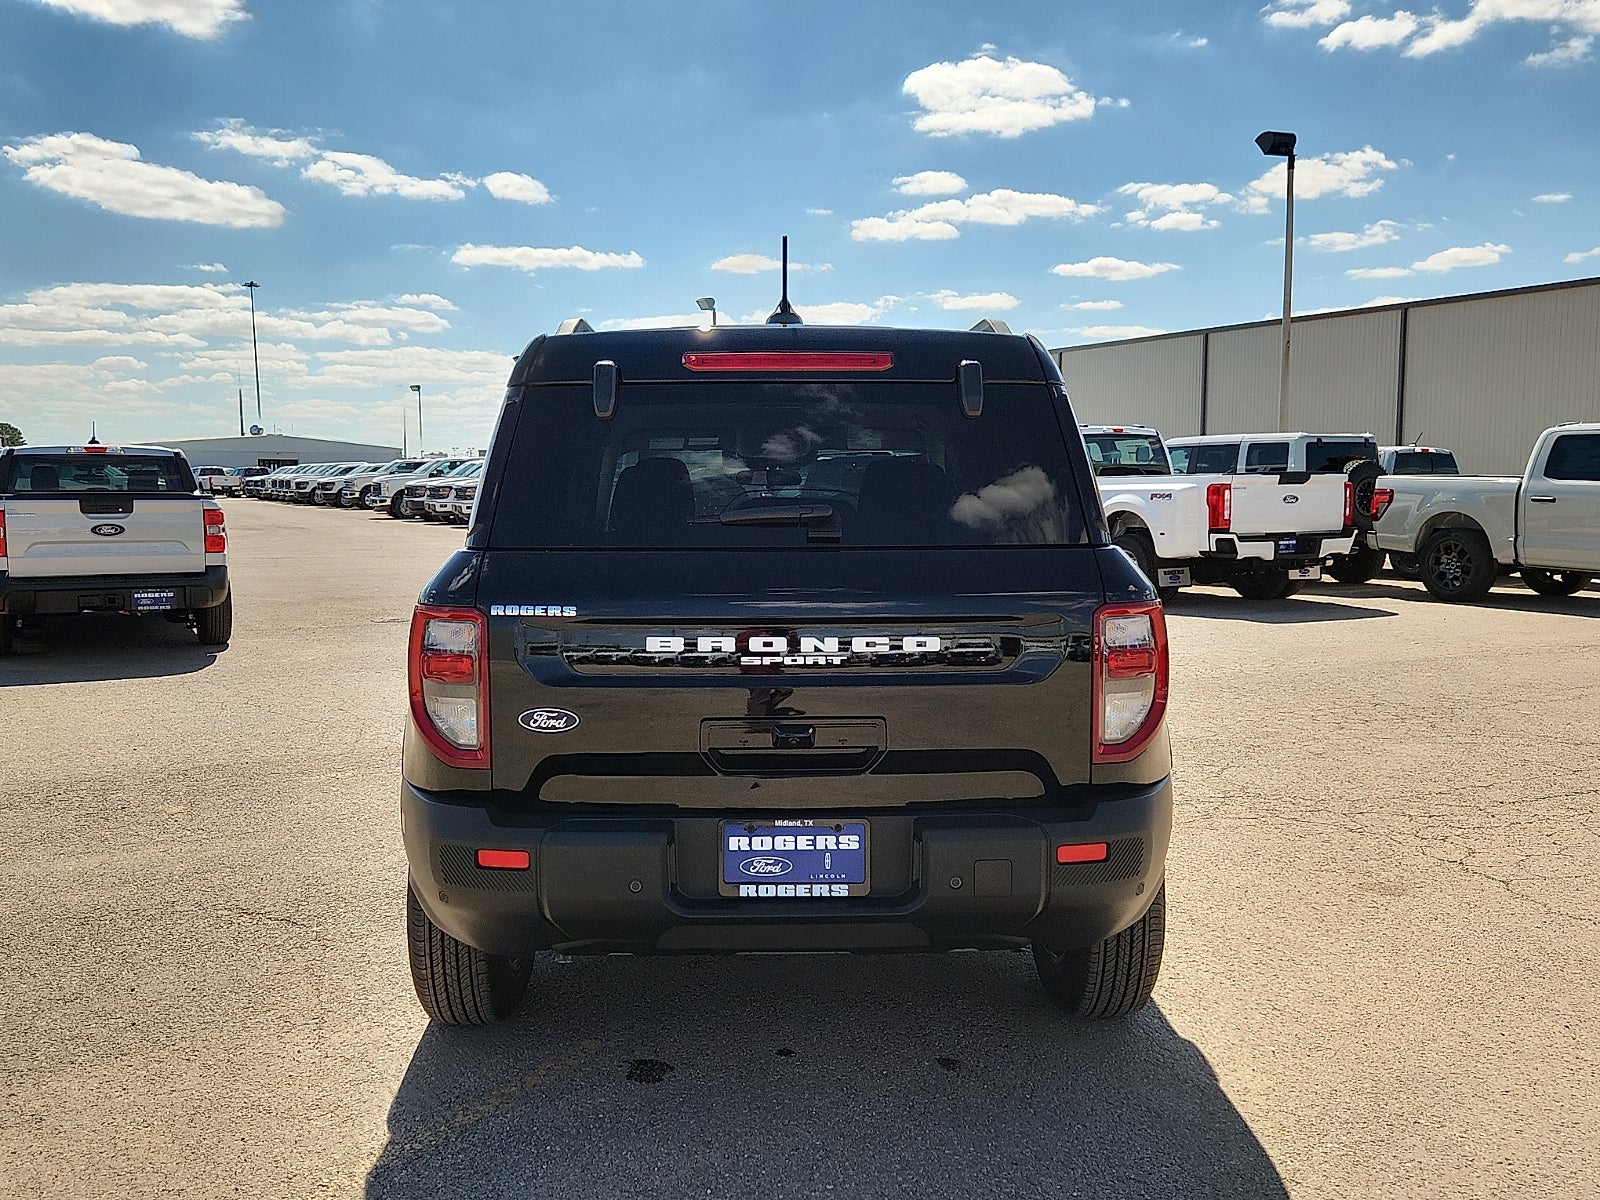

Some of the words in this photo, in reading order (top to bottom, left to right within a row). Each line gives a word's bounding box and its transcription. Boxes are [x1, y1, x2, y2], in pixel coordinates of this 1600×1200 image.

[490, 604, 577, 617] ROGERS
[645, 635, 942, 653] BRONCO
[740, 655, 848, 666] SPORT
[526, 708, 571, 731] Ford
[774, 819, 803, 828] Midland,
[804, 819, 814, 827] TX
[728, 835, 861, 851] ROGERS
[748, 857, 784, 875] Ford
[739, 884, 849, 897] ROGERS
